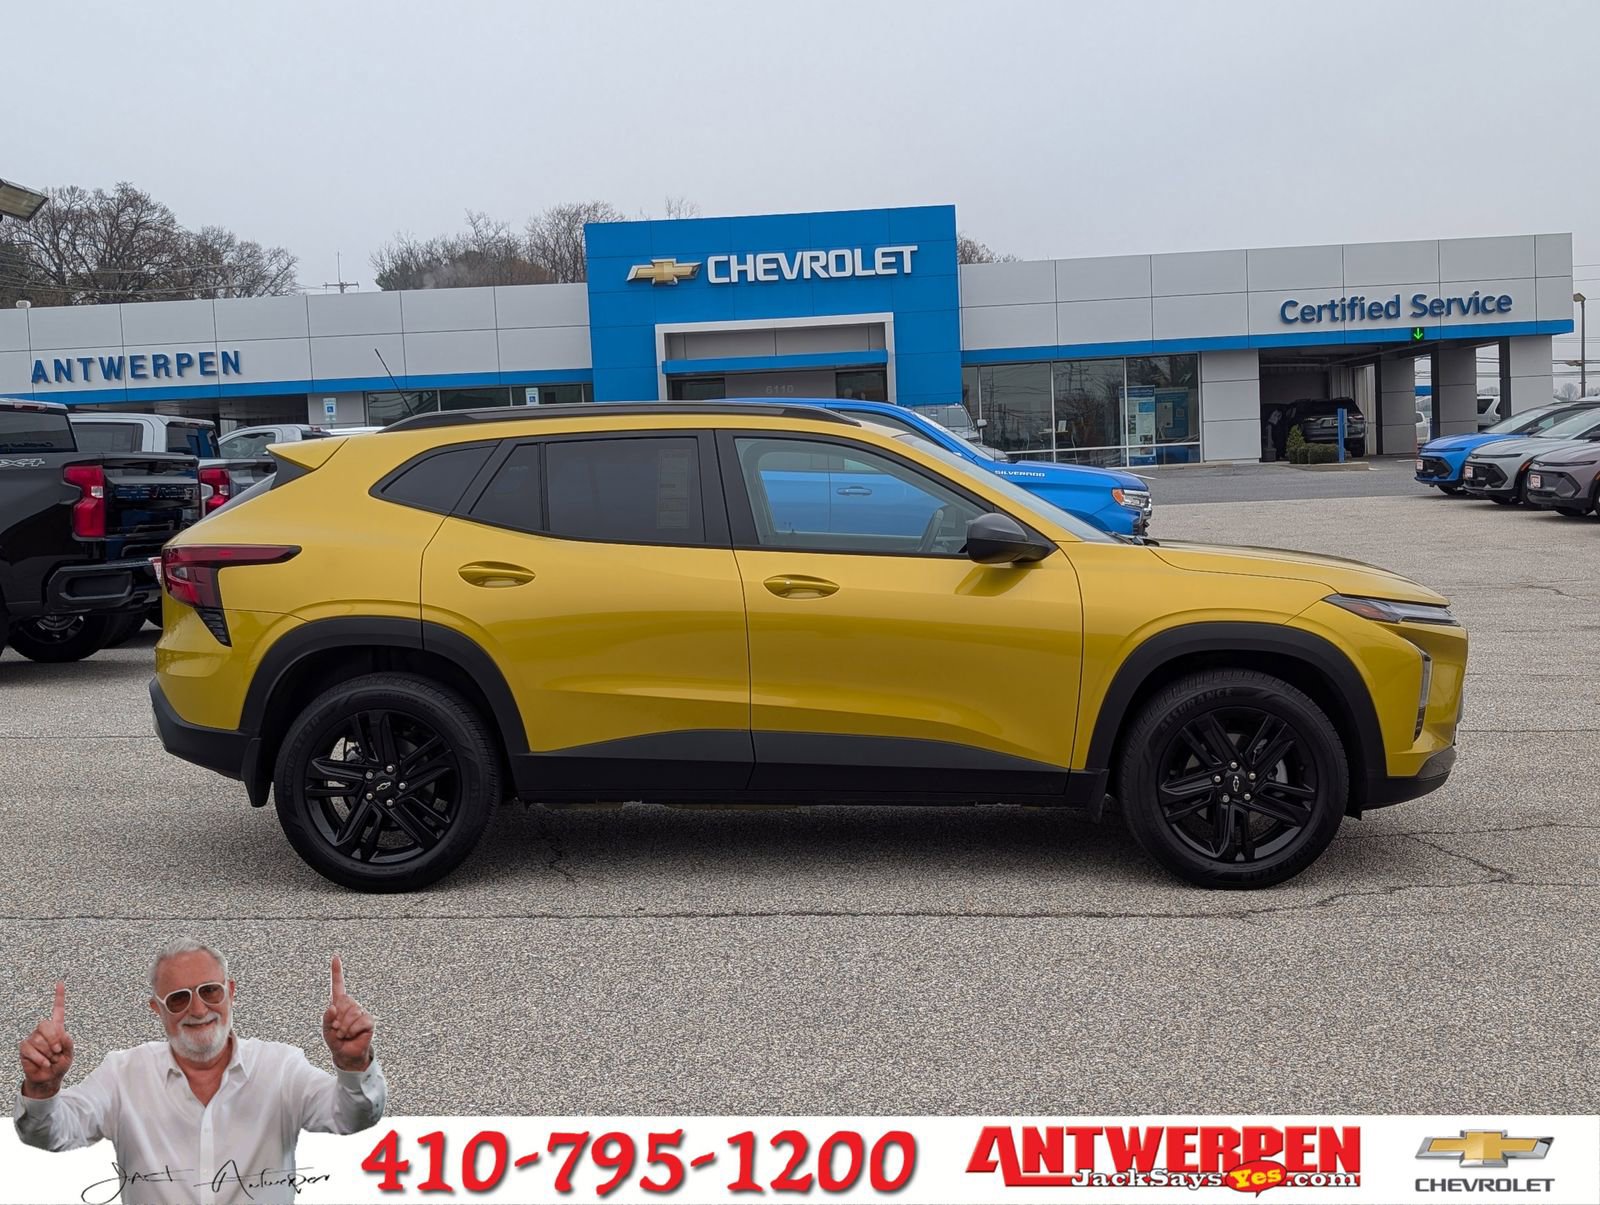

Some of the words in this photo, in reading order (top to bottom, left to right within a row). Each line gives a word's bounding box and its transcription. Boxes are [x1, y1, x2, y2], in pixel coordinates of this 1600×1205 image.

[708, 245, 918, 284] CHEVROLET
[1280, 294, 1401, 324] Certified
[1410, 291, 1513, 319] Service
[31, 350, 242, 383] ANTWERPEN
[766, 385, 794, 394] 6110
